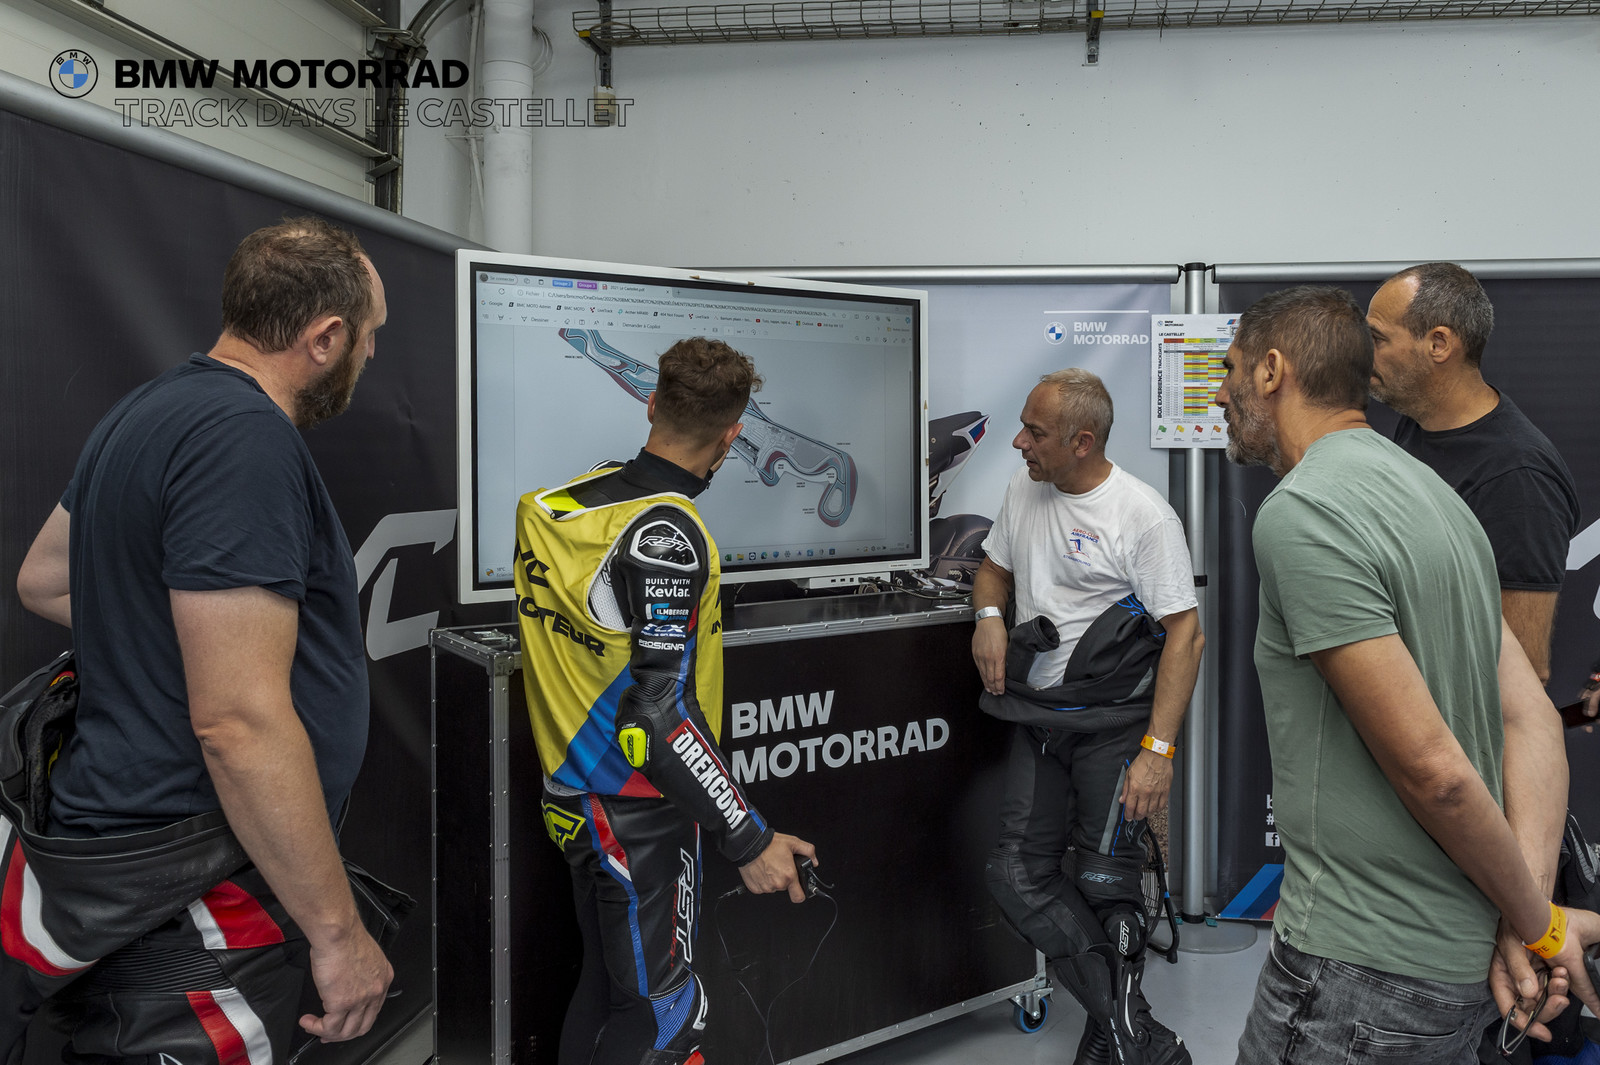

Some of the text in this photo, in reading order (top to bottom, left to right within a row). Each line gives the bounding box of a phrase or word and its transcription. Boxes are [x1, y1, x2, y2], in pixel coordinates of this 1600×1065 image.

[1074, 322, 1107, 332] BMW
[1074, 334, 1149, 344] MOTORRAD
[638, 536, 692, 551] RST
[516, 594, 605, 657] CTEUR
[638, 638, 685, 652] PROSIGNA
[732, 690, 834, 738] BMW
[732, 718, 950, 784] MOTORRAD
[1081, 871, 1123, 883] RST
[676, 847, 694, 964] RST
[1119, 920, 1129, 955] RST
